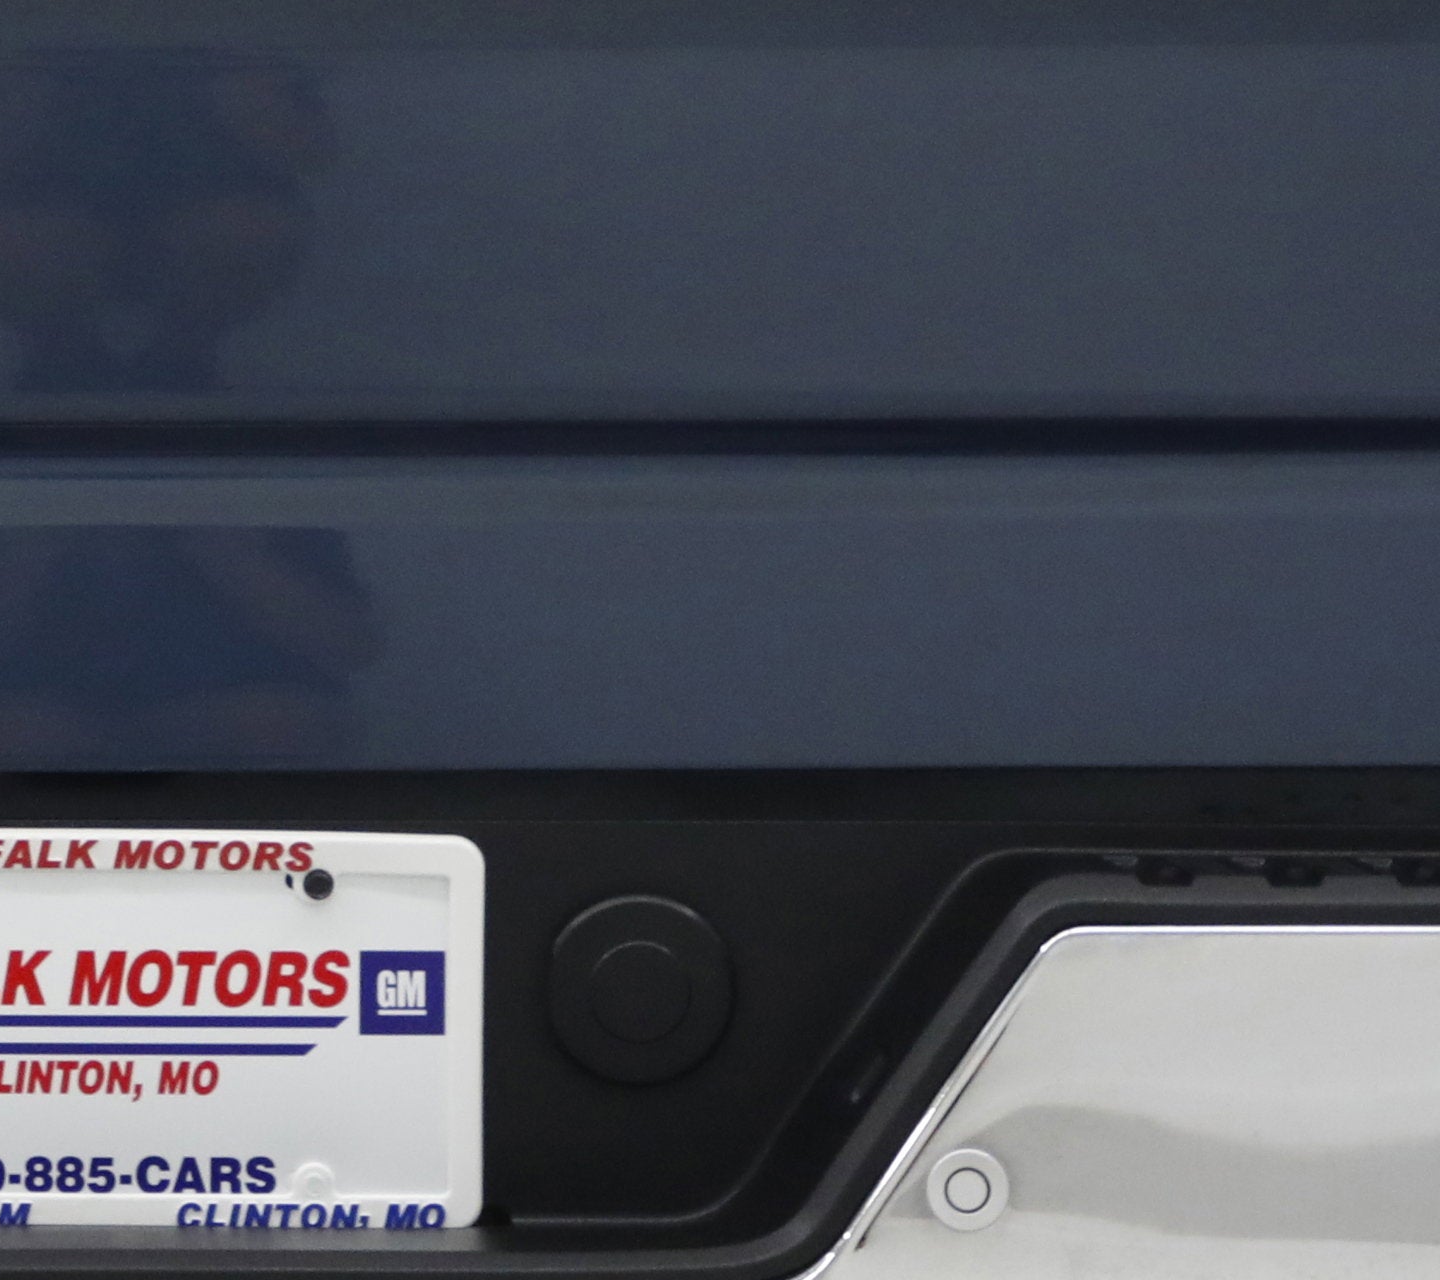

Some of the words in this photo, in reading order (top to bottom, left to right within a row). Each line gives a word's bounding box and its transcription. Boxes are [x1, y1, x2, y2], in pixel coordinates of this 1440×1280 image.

[114, 840, 313, 872] MOTORS
[70, 950, 350, 1008] MOTORS
[376, 970, 426, 1008] GM
[157, 1061, 219, 1095] MO
[176, 1202, 371, 1228] CLINTON,
[384, 1203, 447, 1229] MO
